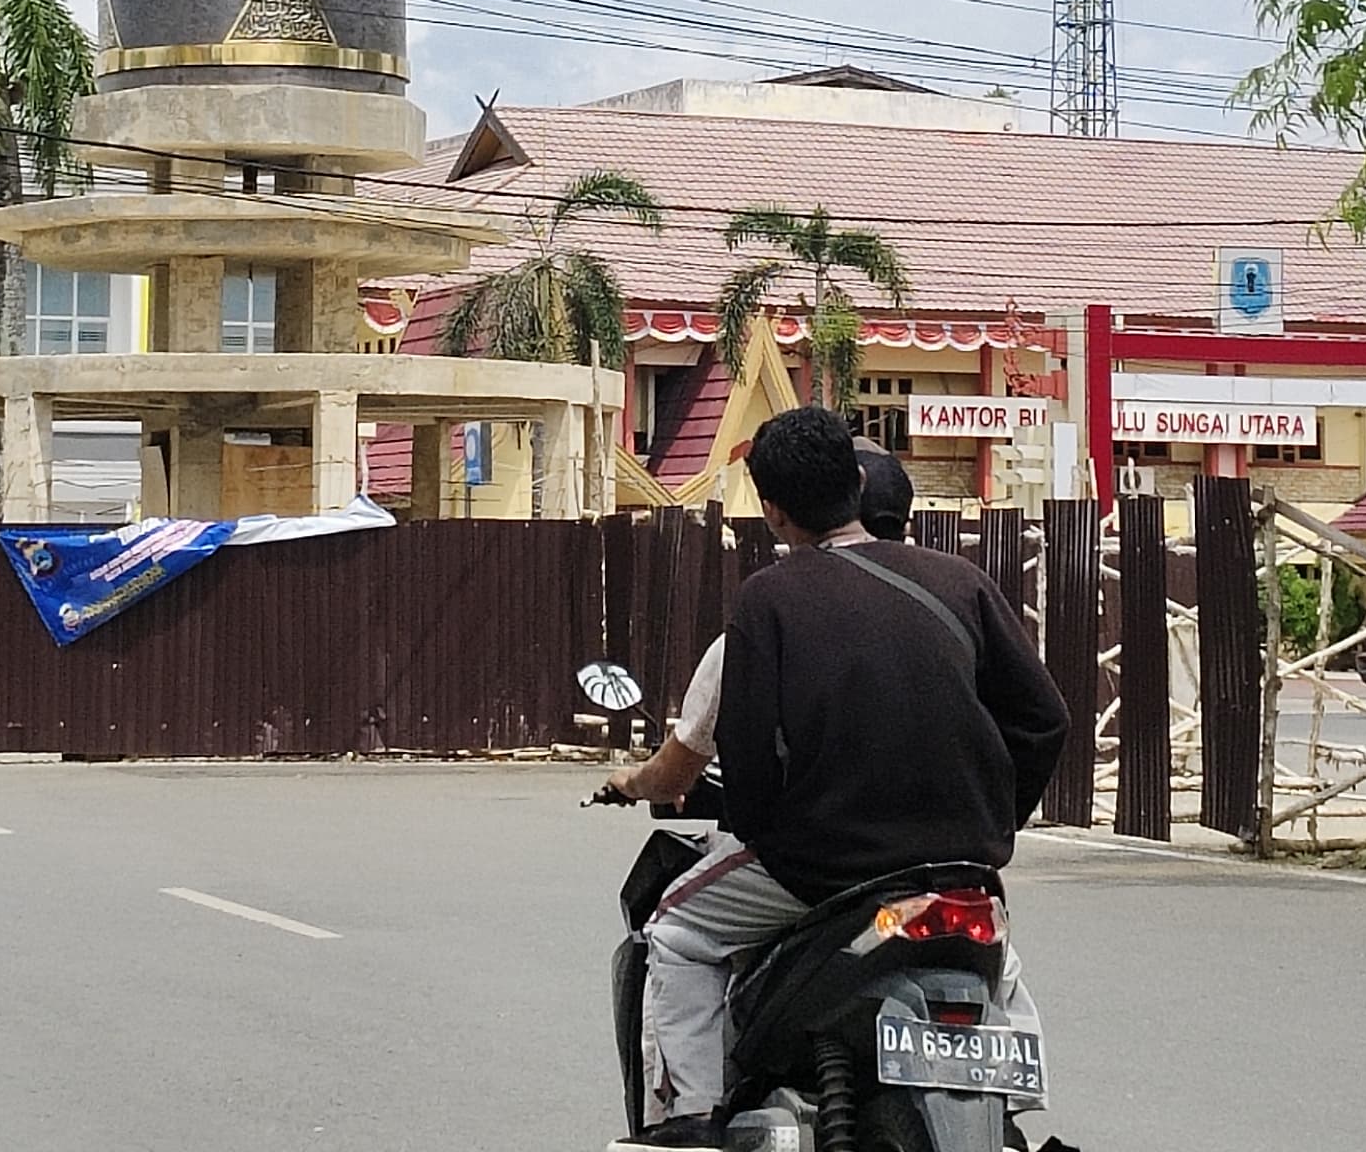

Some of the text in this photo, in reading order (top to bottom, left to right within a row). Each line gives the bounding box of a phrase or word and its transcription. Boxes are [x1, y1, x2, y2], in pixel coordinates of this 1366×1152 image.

[920, 404, 1007, 430] KANTOR
[1112, 409, 1146, 432] ULU
[1156, 411, 1230, 435] SUNGAI
[1239, 413, 1305, 436] UTARA
[883, 1024, 915, 1053] DA
[922, 1030, 983, 1061] 6529
